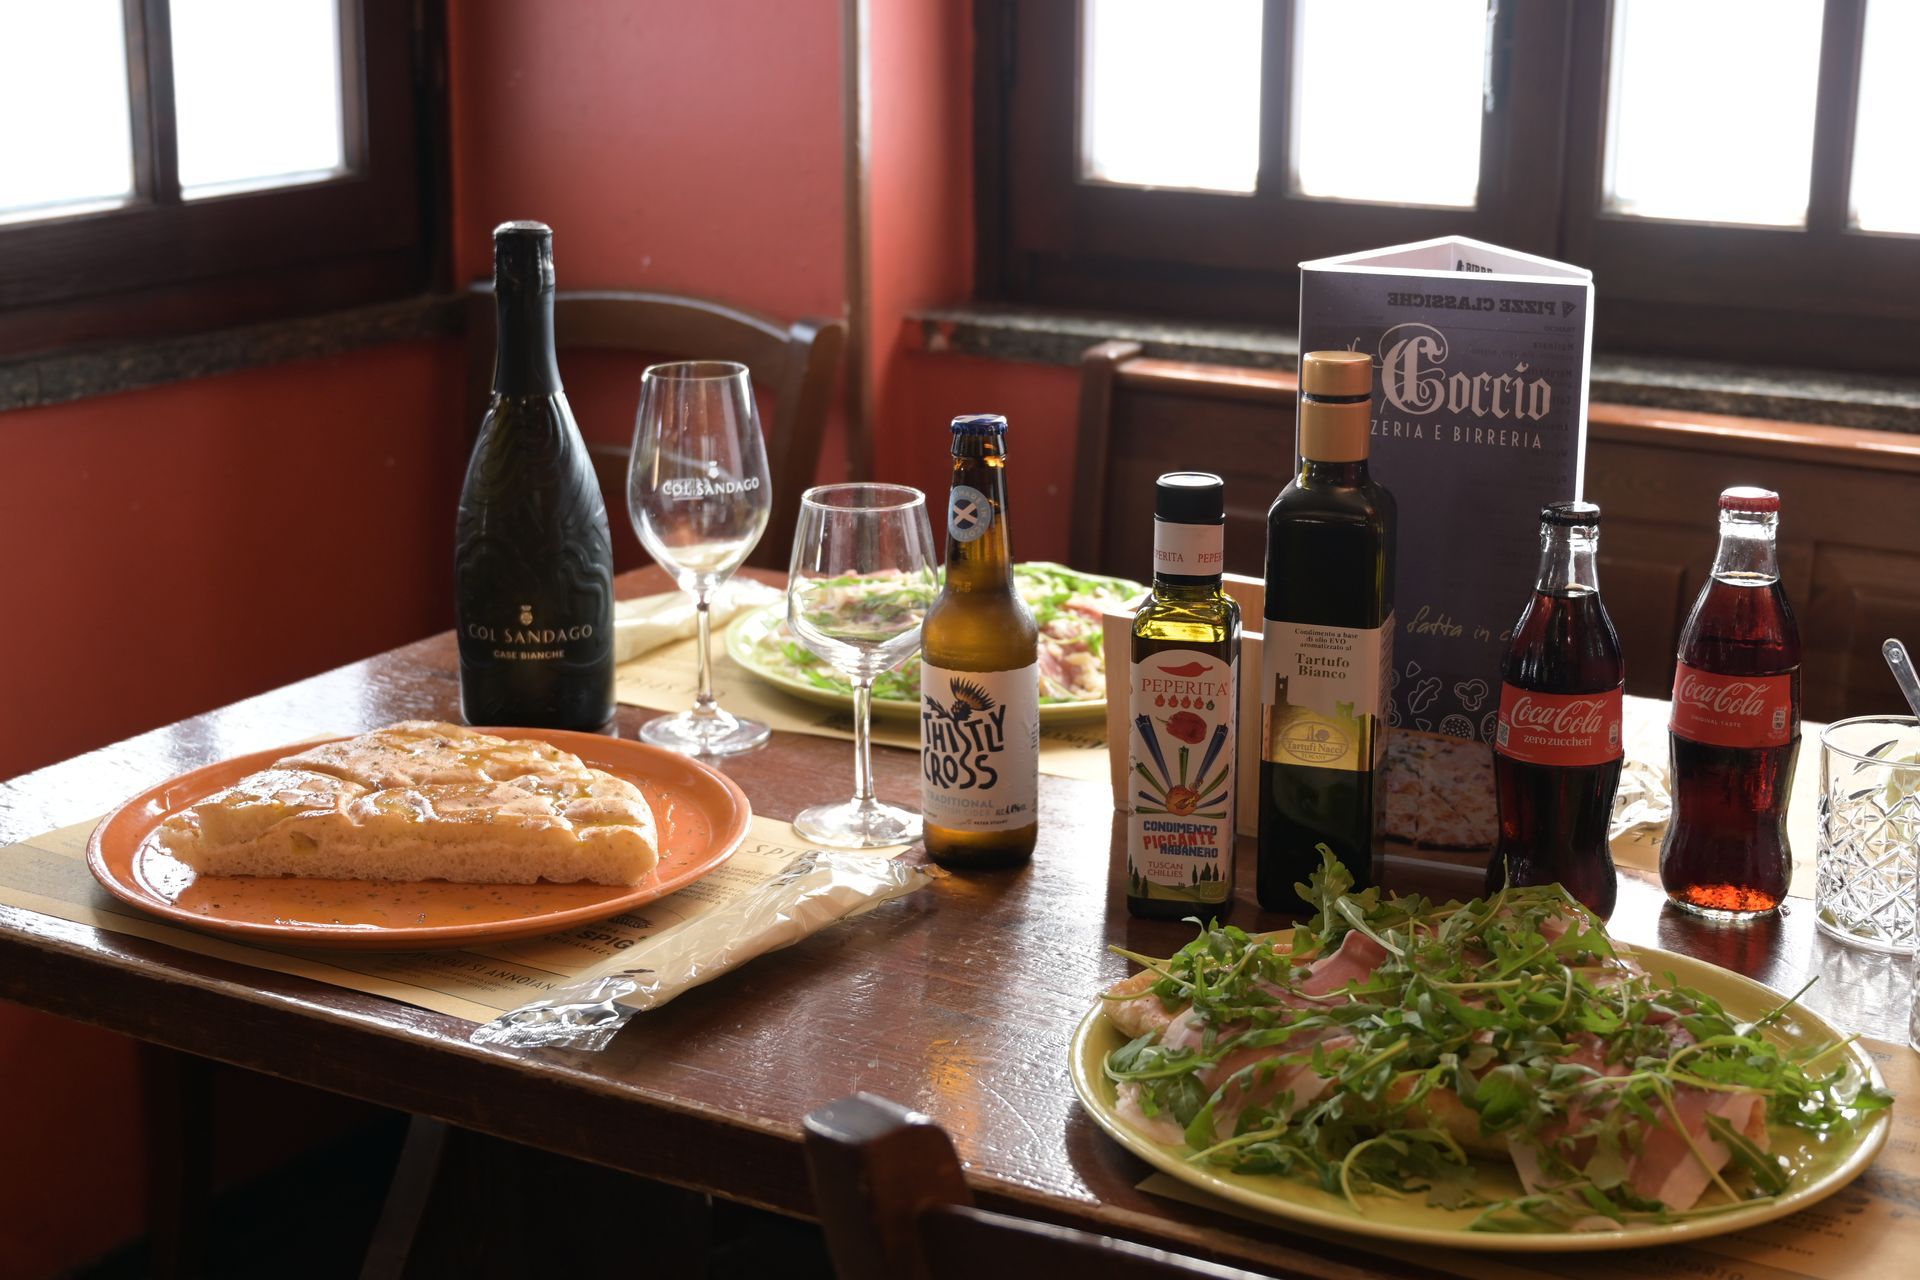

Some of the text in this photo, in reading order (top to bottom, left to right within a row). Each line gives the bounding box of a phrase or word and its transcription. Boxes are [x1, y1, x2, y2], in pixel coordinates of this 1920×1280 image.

[1378, 322, 1552, 421] Coccio
[1370, 419, 1542, 449] ZERIA E BIRRERIA
[662, 477, 760, 496] COL SANDAGO
[1155, 550, 1223, 564] PERITA PEPER
[468, 624, 593, 644] COL SANDAGO
[1294, 628, 1337, 638] Condimento
[1473, 625, 1490, 642] in
[1329, 638, 1346, 646] EVO
[520, 650, 565, 660] BIANCHE
[1294, 653, 1350, 668] Tartufo
[1298, 665, 1347, 680] Bianco
[1141, 678, 1227, 697] PEPERITA
[922, 704, 1006, 753] THISTLY
[1524, 735, 1547, 745] zero
[1547, 735, 1592, 748] zuccheri
[924, 748, 998, 790] CROSS
[1143, 820, 1218, 835] CONDIMENTO
[1142, 831, 1216, 850] PICCANTE
[746, 843, 796, 860] SPI
[1147, 861, 1184, 870] TUSCAN
[1147, 869, 1184, 878] CHILLIES
[576, 929, 635, 950] SPIG
[487, 968, 558, 991] ANNOIAN
